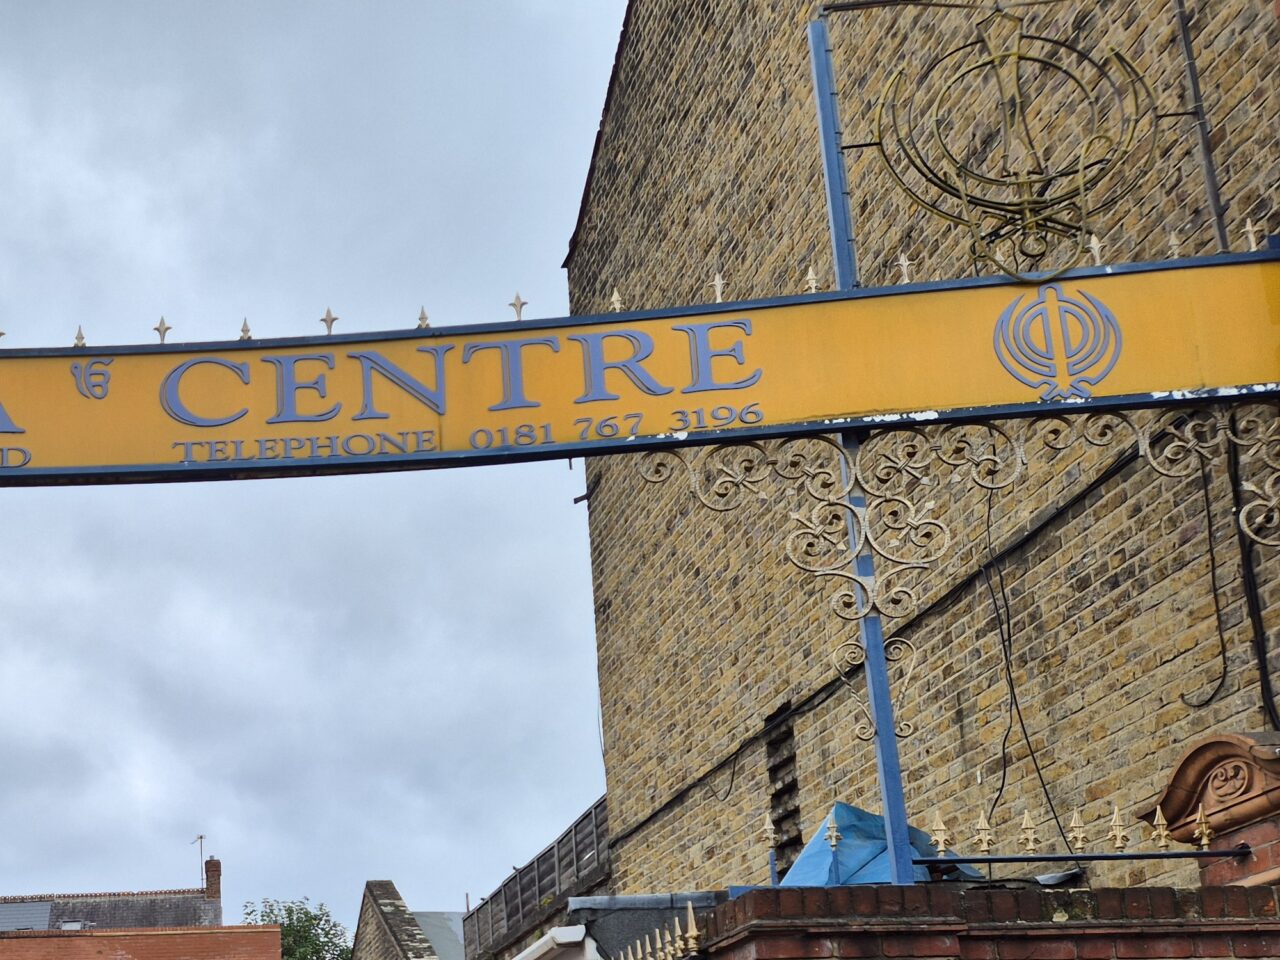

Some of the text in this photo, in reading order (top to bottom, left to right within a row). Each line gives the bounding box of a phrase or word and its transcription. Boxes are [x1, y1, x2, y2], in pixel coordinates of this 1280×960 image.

[159, 319, 763, 427] CENTRE
[173, 402, 765, 464] TELEPHONE 0181 767 3196
